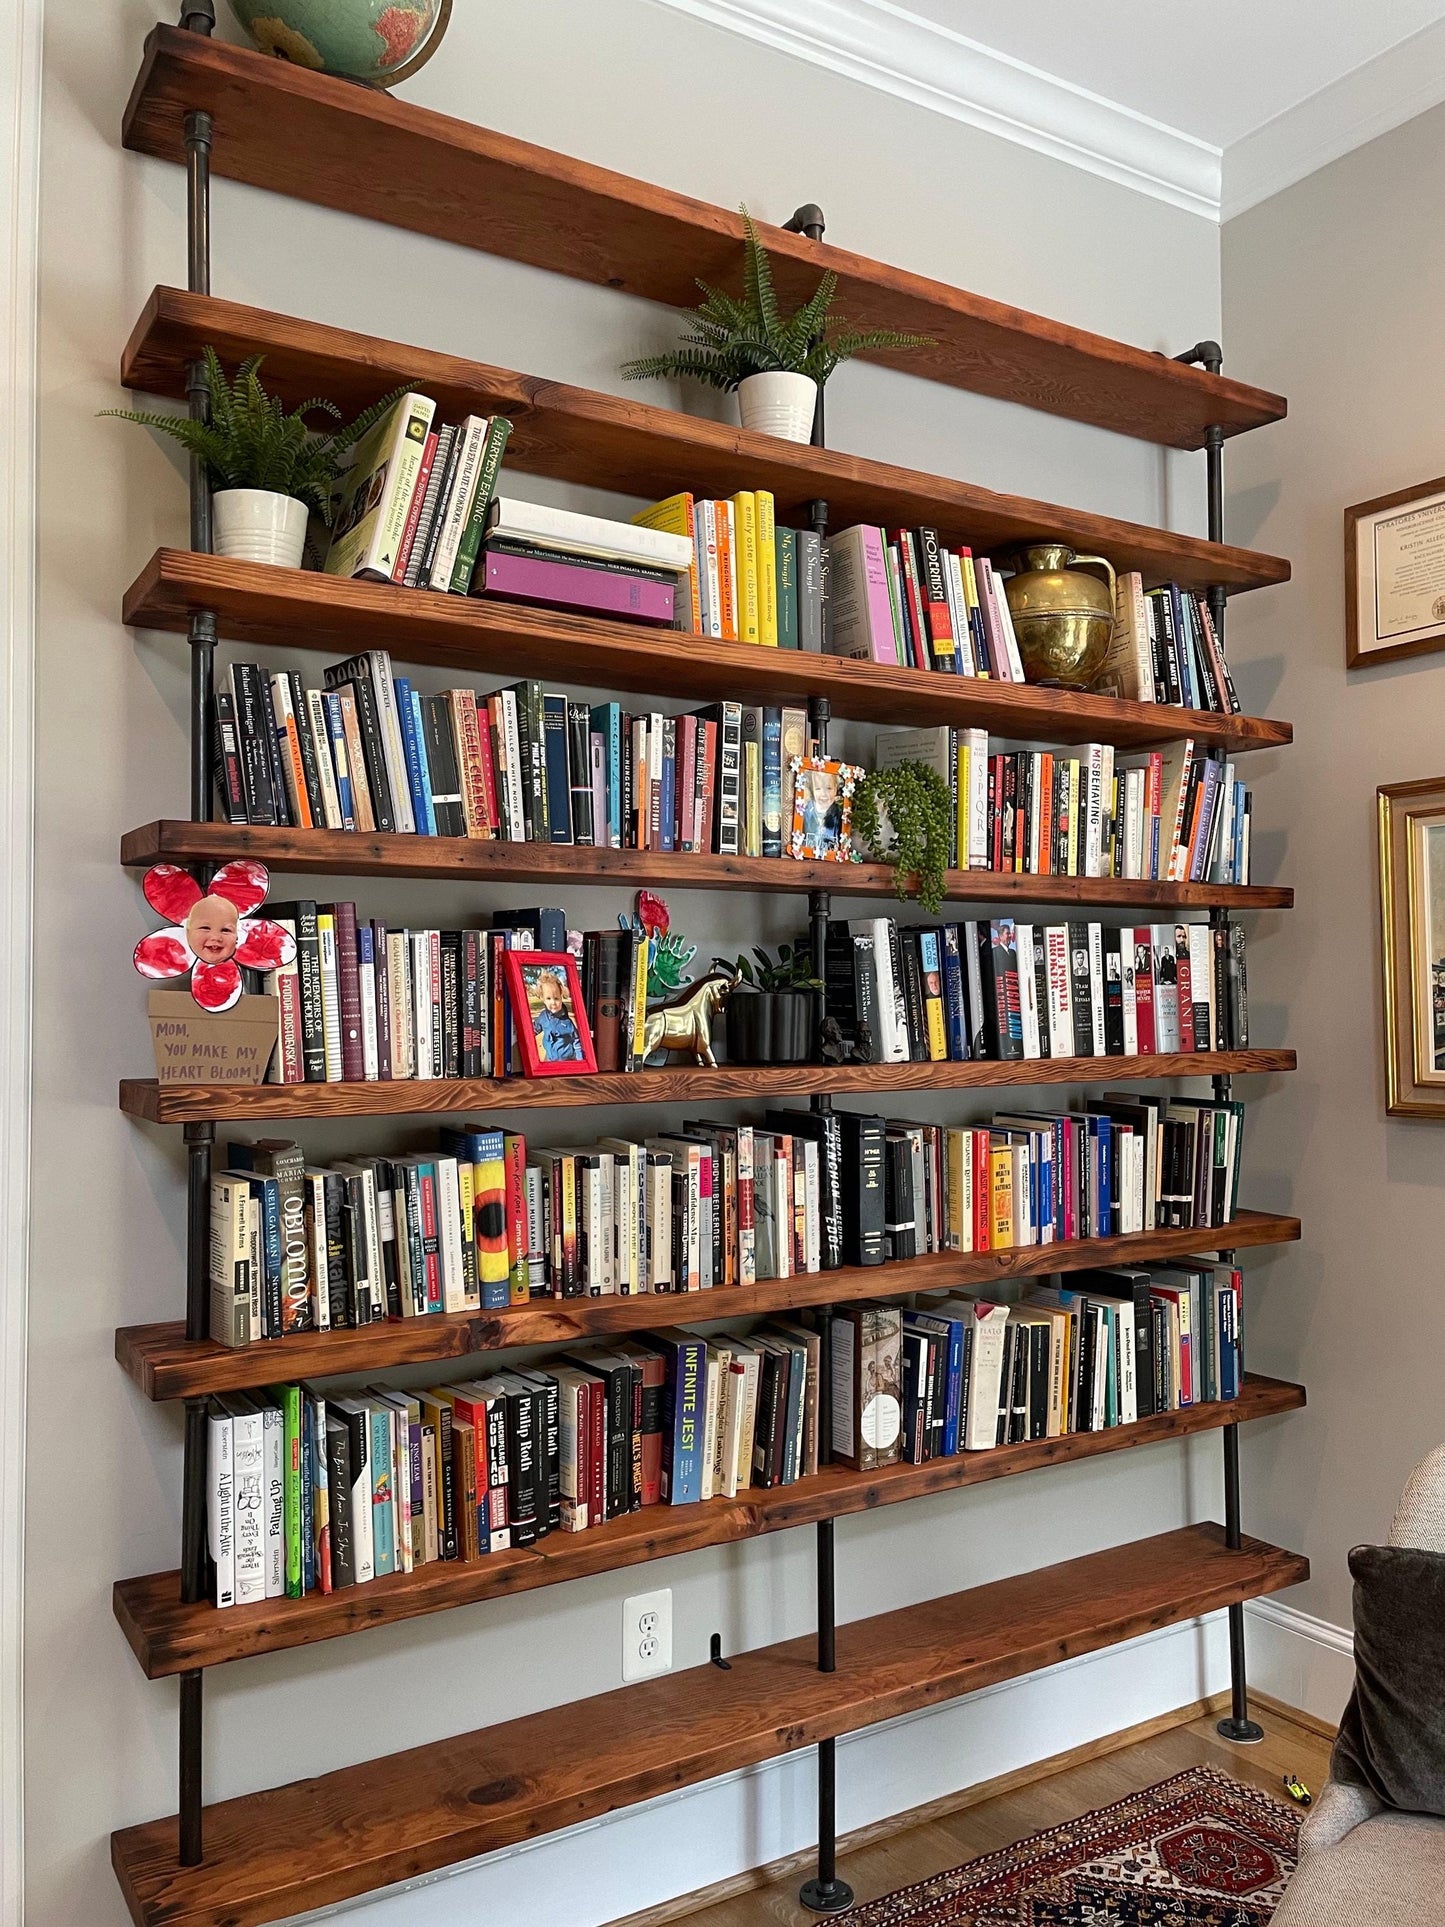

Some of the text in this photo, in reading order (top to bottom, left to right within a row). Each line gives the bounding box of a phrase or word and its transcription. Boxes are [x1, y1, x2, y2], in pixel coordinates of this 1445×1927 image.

[452, 427, 481, 525] THE SILVER PALATE COOKBOOK
[484, 431, 504, 479] HARVEST
[391, 455, 419, 542] heart of the artichoke
[473, 481, 490, 523] EATING
[399, 483, 425, 563] DUTCH OVEN COOKBOOK
[744, 506, 755, 618] emily oster cribsheet
[782, 533, 792, 590] My Struggle
[806, 538, 818, 594] My Struggle
[924, 530, 944, 600] MODERNISM
[1400, 540, 1423, 551] KRISTIN
[1162, 596, 1177, 686] DARK MONEY JANE MAYER
[241, 666, 256, 734] Richard Brautigan
[381, 677, 390, 708] AUSTER
[267, 708, 279, 767] STRANGER
[312, 700, 324, 737] FOUNDATION
[406, 706, 414, 735] AUSTER
[289, 725, 303, 786] LEVIATHAN
[409, 740, 418, 771] ORACLE
[461, 696, 485, 827] MICHAEL CHABON
[532, 742, 540, 766] PHILIP
[533, 768, 540, 777] K.
[696, 757, 704, 785] THIEVES
[413, 773, 421, 798] NIGHT
[1090, 749, 1101, 825] MISBEHAVING
[1206, 779, 1214, 805] EVIL
[889, 927, 898, 977] KATHARINE
[1057, 931, 1068, 1012] THE POWER
[301, 950, 313, 1038] SHERLOCK HOLMES
[312, 977, 321, 1017] MEMOIRS
[432, 973, 438, 981] AT
[907, 953, 915, 993] AUGUSTINE
[911, 995, 916, 1004] OF
[1179, 966, 1192, 1030] GRANT
[283, 979, 296, 1066] FYODOR DOSTOEVSKY
[314, 1020, 322, 1032] OF
[636, 1001, 644, 1037] MONGRELS
[997, 995, 1006, 1034] PERLSTEIN
[1005, 970, 1022, 1040] REAGANLAND
[156, 1023, 190, 1038] MOM,
[164, 1043, 257, 1060] YOU MAKE MY
[161, 1063, 260, 1080] HEART BLOOM!
[512, 1143, 521, 1173] Deacon
[808, 1163, 816, 1186] Snow
[824, 1131, 840, 1199] PYNCHON
[512, 1174, 521, 1192] King
[516, 1219, 524, 1246] James
[690, 1183, 698, 1245] Confidence-Man
[712, 1213, 720, 1247] LERNER
[825, 1216, 839, 1252] EDGE
[268, 1188, 280, 1326] NEIL GAIMAN NEVERWHERE
[284, 1196, 309, 1314] OBLOMOV
[516, 1248, 524, 1281] McBride
[682, 1347, 698, 1452] INFINITE JEST
[743, 1363, 756, 1461] ALL THE KING'S MEN
[374, 1426, 380, 1434] OF
[441, 1411, 452, 1461] ABSURDISTAN
[497, 1421, 505, 1465] ARCHIPELAGO
[517, 1397, 532, 1472] Philip Roth
[490, 1423, 499, 1486] GULAG
[632, 1432, 642, 1493] HELL'S ANGELS
[217, 1481, 232, 1505] Light
[220, 1473, 231, 1481] A
[221, 1506, 231, 1516] in
[221, 1517, 232, 1533] the
[220, 1533, 232, 1557] Attic
